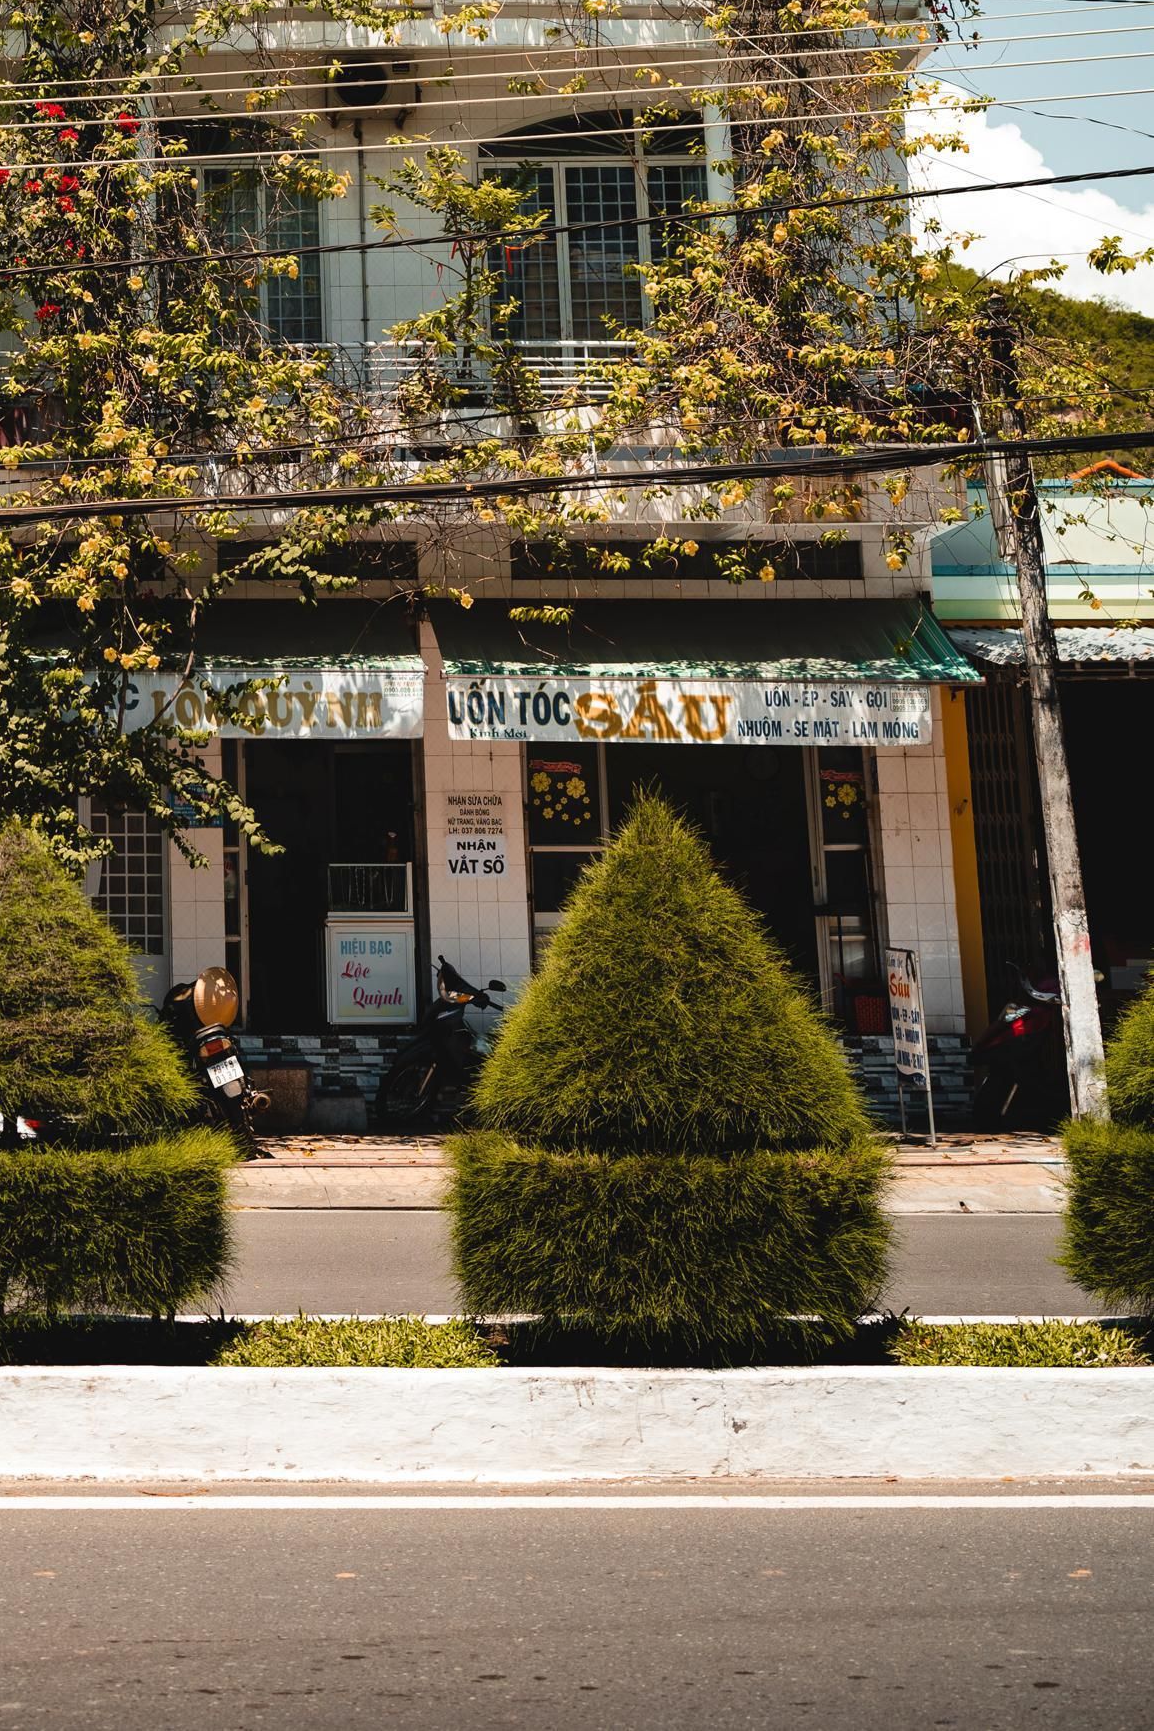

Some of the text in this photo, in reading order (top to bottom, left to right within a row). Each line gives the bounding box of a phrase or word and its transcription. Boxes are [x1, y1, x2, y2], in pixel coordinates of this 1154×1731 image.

[238, 681, 383, 736] QUỲNH
[765, 684, 791, 707] UỐN
[866, 686, 887, 712] GỘI
[448, 679, 505, 725] UỐN
[514, 682, 570, 726] TÓC
[574, 681, 731, 741] SÁU
[738, 715, 919, 743] NHUỘM SE MẶT LÀM MÓNG
[448, 794, 502, 808] NHẬN SỬA CHỮA
[457, 839, 496, 852] NHẬN
[448, 854, 504, 874] VẮT SỔ
[340, 937, 392, 958] HIỆU BẠC
[340, 960, 370, 982] Lộc
[352, 986, 404, 1009] Quỳnh
[889, 973, 910, 999] Sáu
